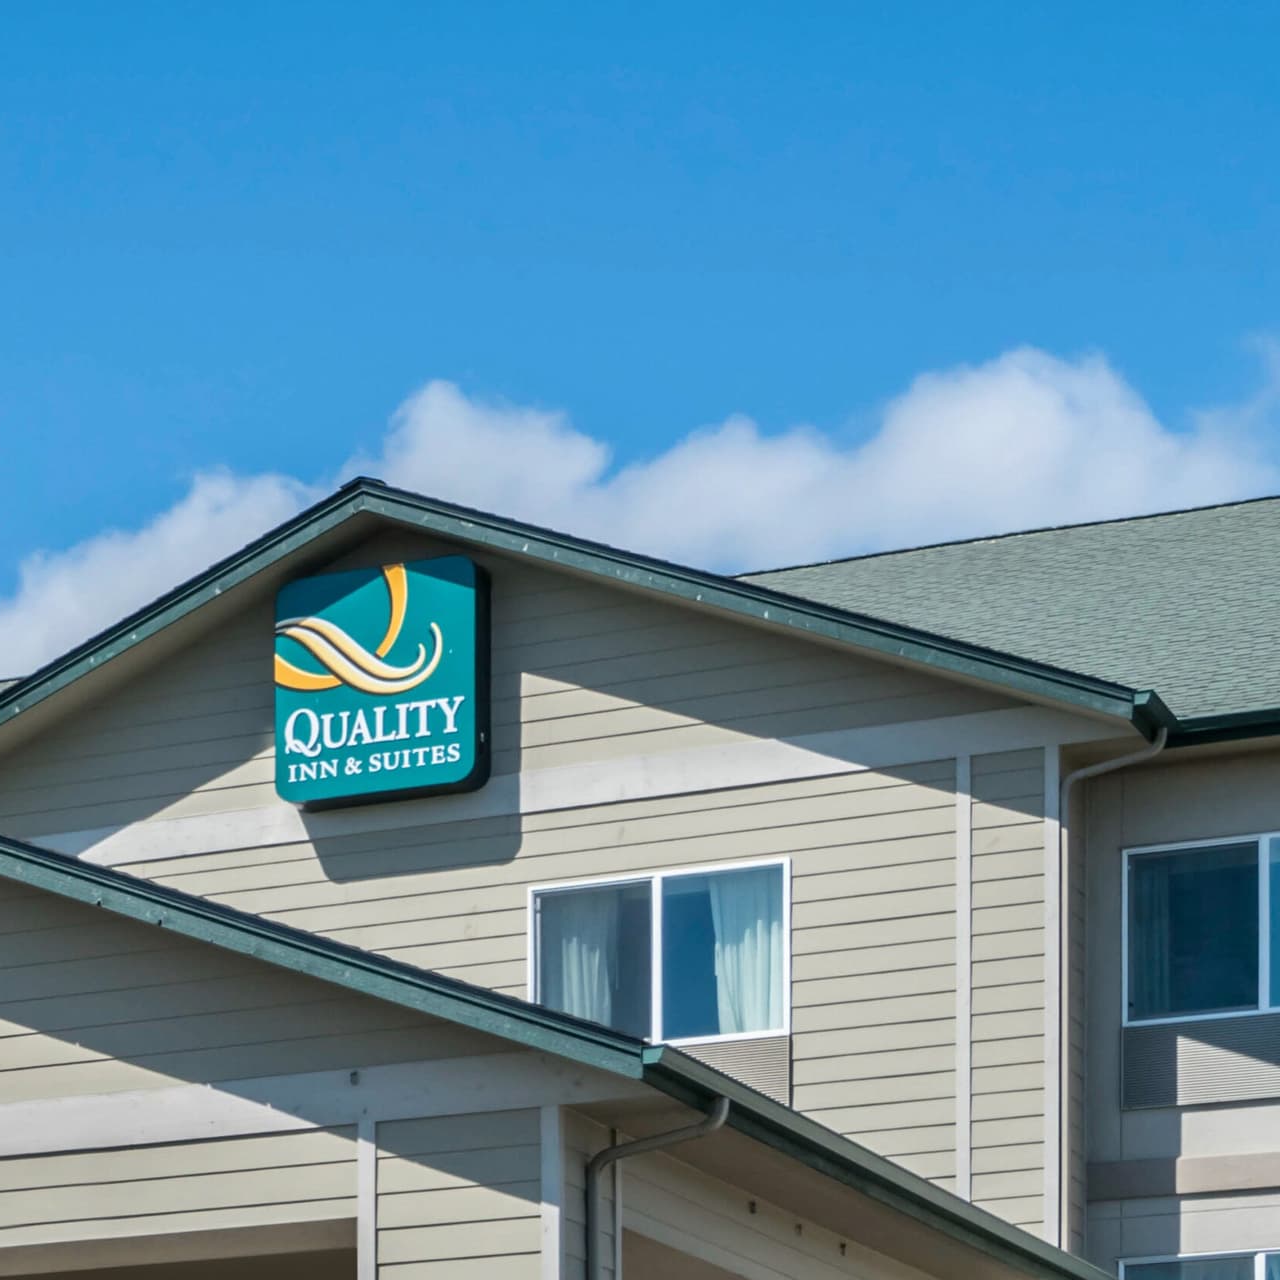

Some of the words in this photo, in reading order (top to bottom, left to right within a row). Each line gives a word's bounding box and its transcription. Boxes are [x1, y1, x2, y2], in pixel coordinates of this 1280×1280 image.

[284, 695, 465, 757] QUALITY
[287, 758, 339, 783] INN
[344, 756, 363, 776] &
[368, 743, 461, 772] SUITES
